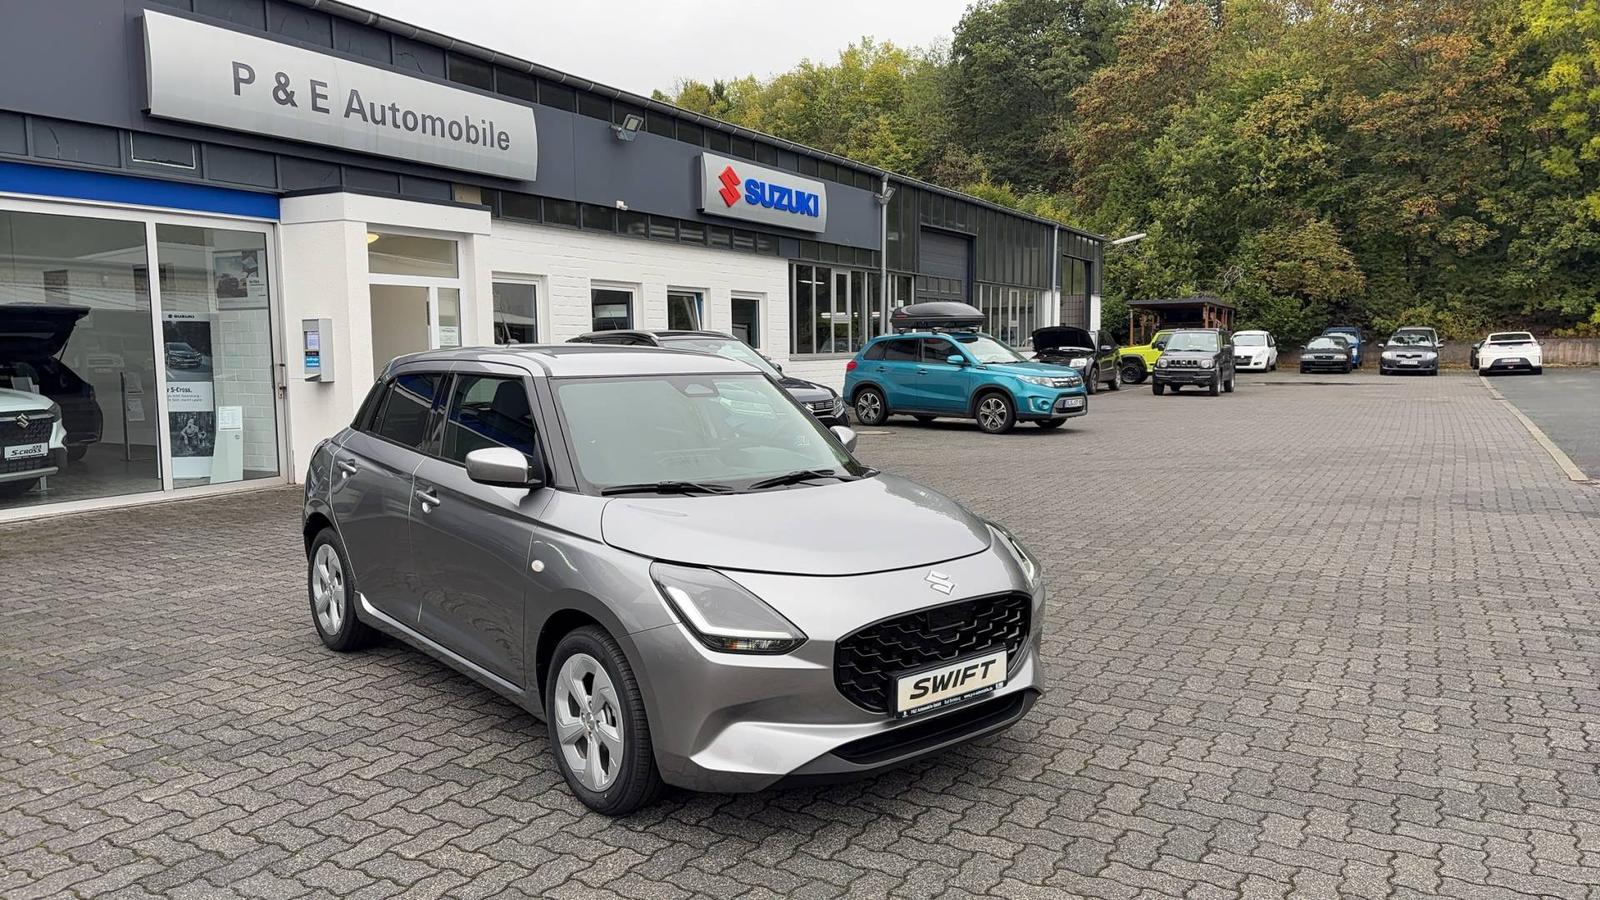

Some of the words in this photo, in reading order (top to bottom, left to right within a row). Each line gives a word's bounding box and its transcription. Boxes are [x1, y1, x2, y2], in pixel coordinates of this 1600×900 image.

[231, 60, 256, 96] P
[272, 71, 298, 107] &
[309, 79, 330, 114] E
[343, 88, 510, 151] Automobile
[744, 178, 819, 218] SUZUKI
[909, 659, 997, 700] SWIFT
